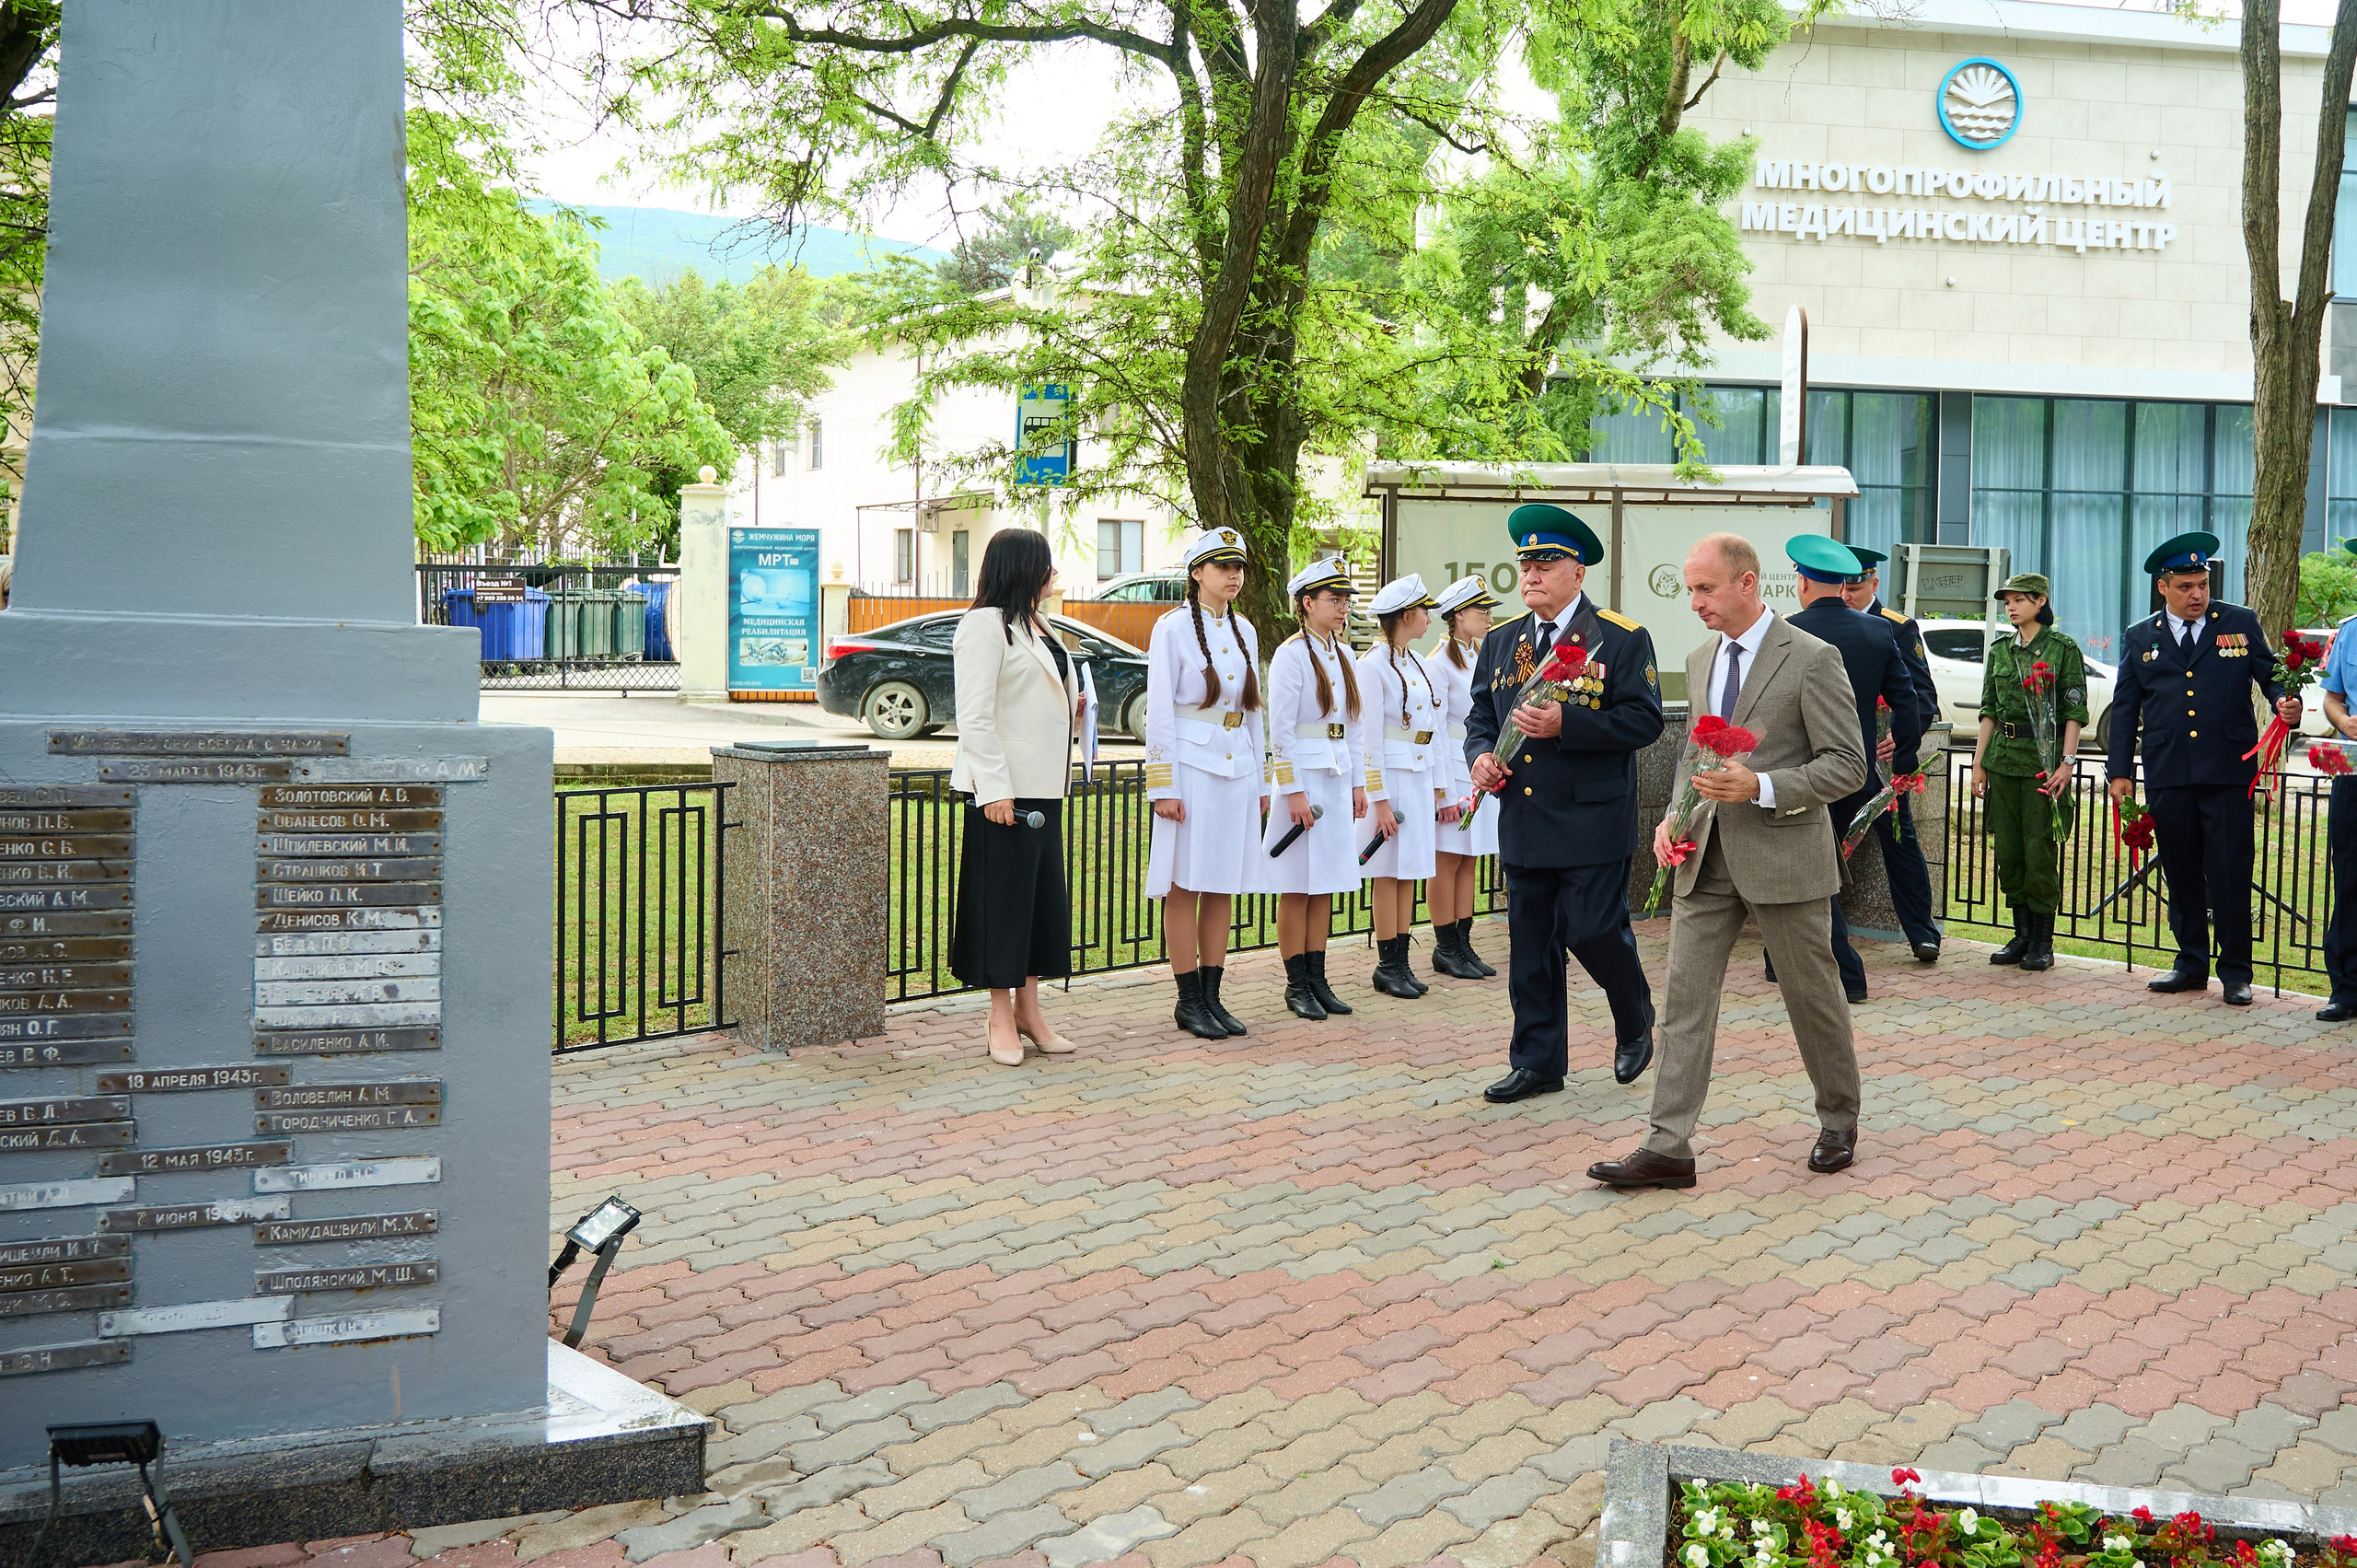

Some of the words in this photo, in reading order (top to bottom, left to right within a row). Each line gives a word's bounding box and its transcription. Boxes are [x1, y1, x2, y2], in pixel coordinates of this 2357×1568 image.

[1755, 158, 2173, 209] МНОГОПРОФИЛЬНЫЙ
[1740, 200, 2048, 246] МЕДИЦИНСКИЙ
[2055, 217, 2178, 253] ЦЕНТР
[749, 533, 794, 541] ЖЕМЧУЖИНА
[759, 553, 792, 566] МРТ
[743, 618, 806, 627] МЕДИЦИНСКАЯ
[741, 627, 807, 636] РЕАБИЛИТАЦИЯ
[138, 738, 156, 749] НО
[163, 739, 191, 750] ОНИ
[198, 738, 255, 750] ВСЕГДА
[264, 739, 273, 750] С
[281, 739, 323, 750] НАМИ
[159, 765, 210, 777] МАРТА
[127, 1074, 145, 1090] 18
[152, 1074, 207, 1088] АПРЕЛЯ
[141, 1154, 158, 1169] 12
[166, 1153, 199, 1167] МАЯ
[137, 1212, 147, 1226] 7
[156, 1210, 197, 1225] ИЮНЯ
